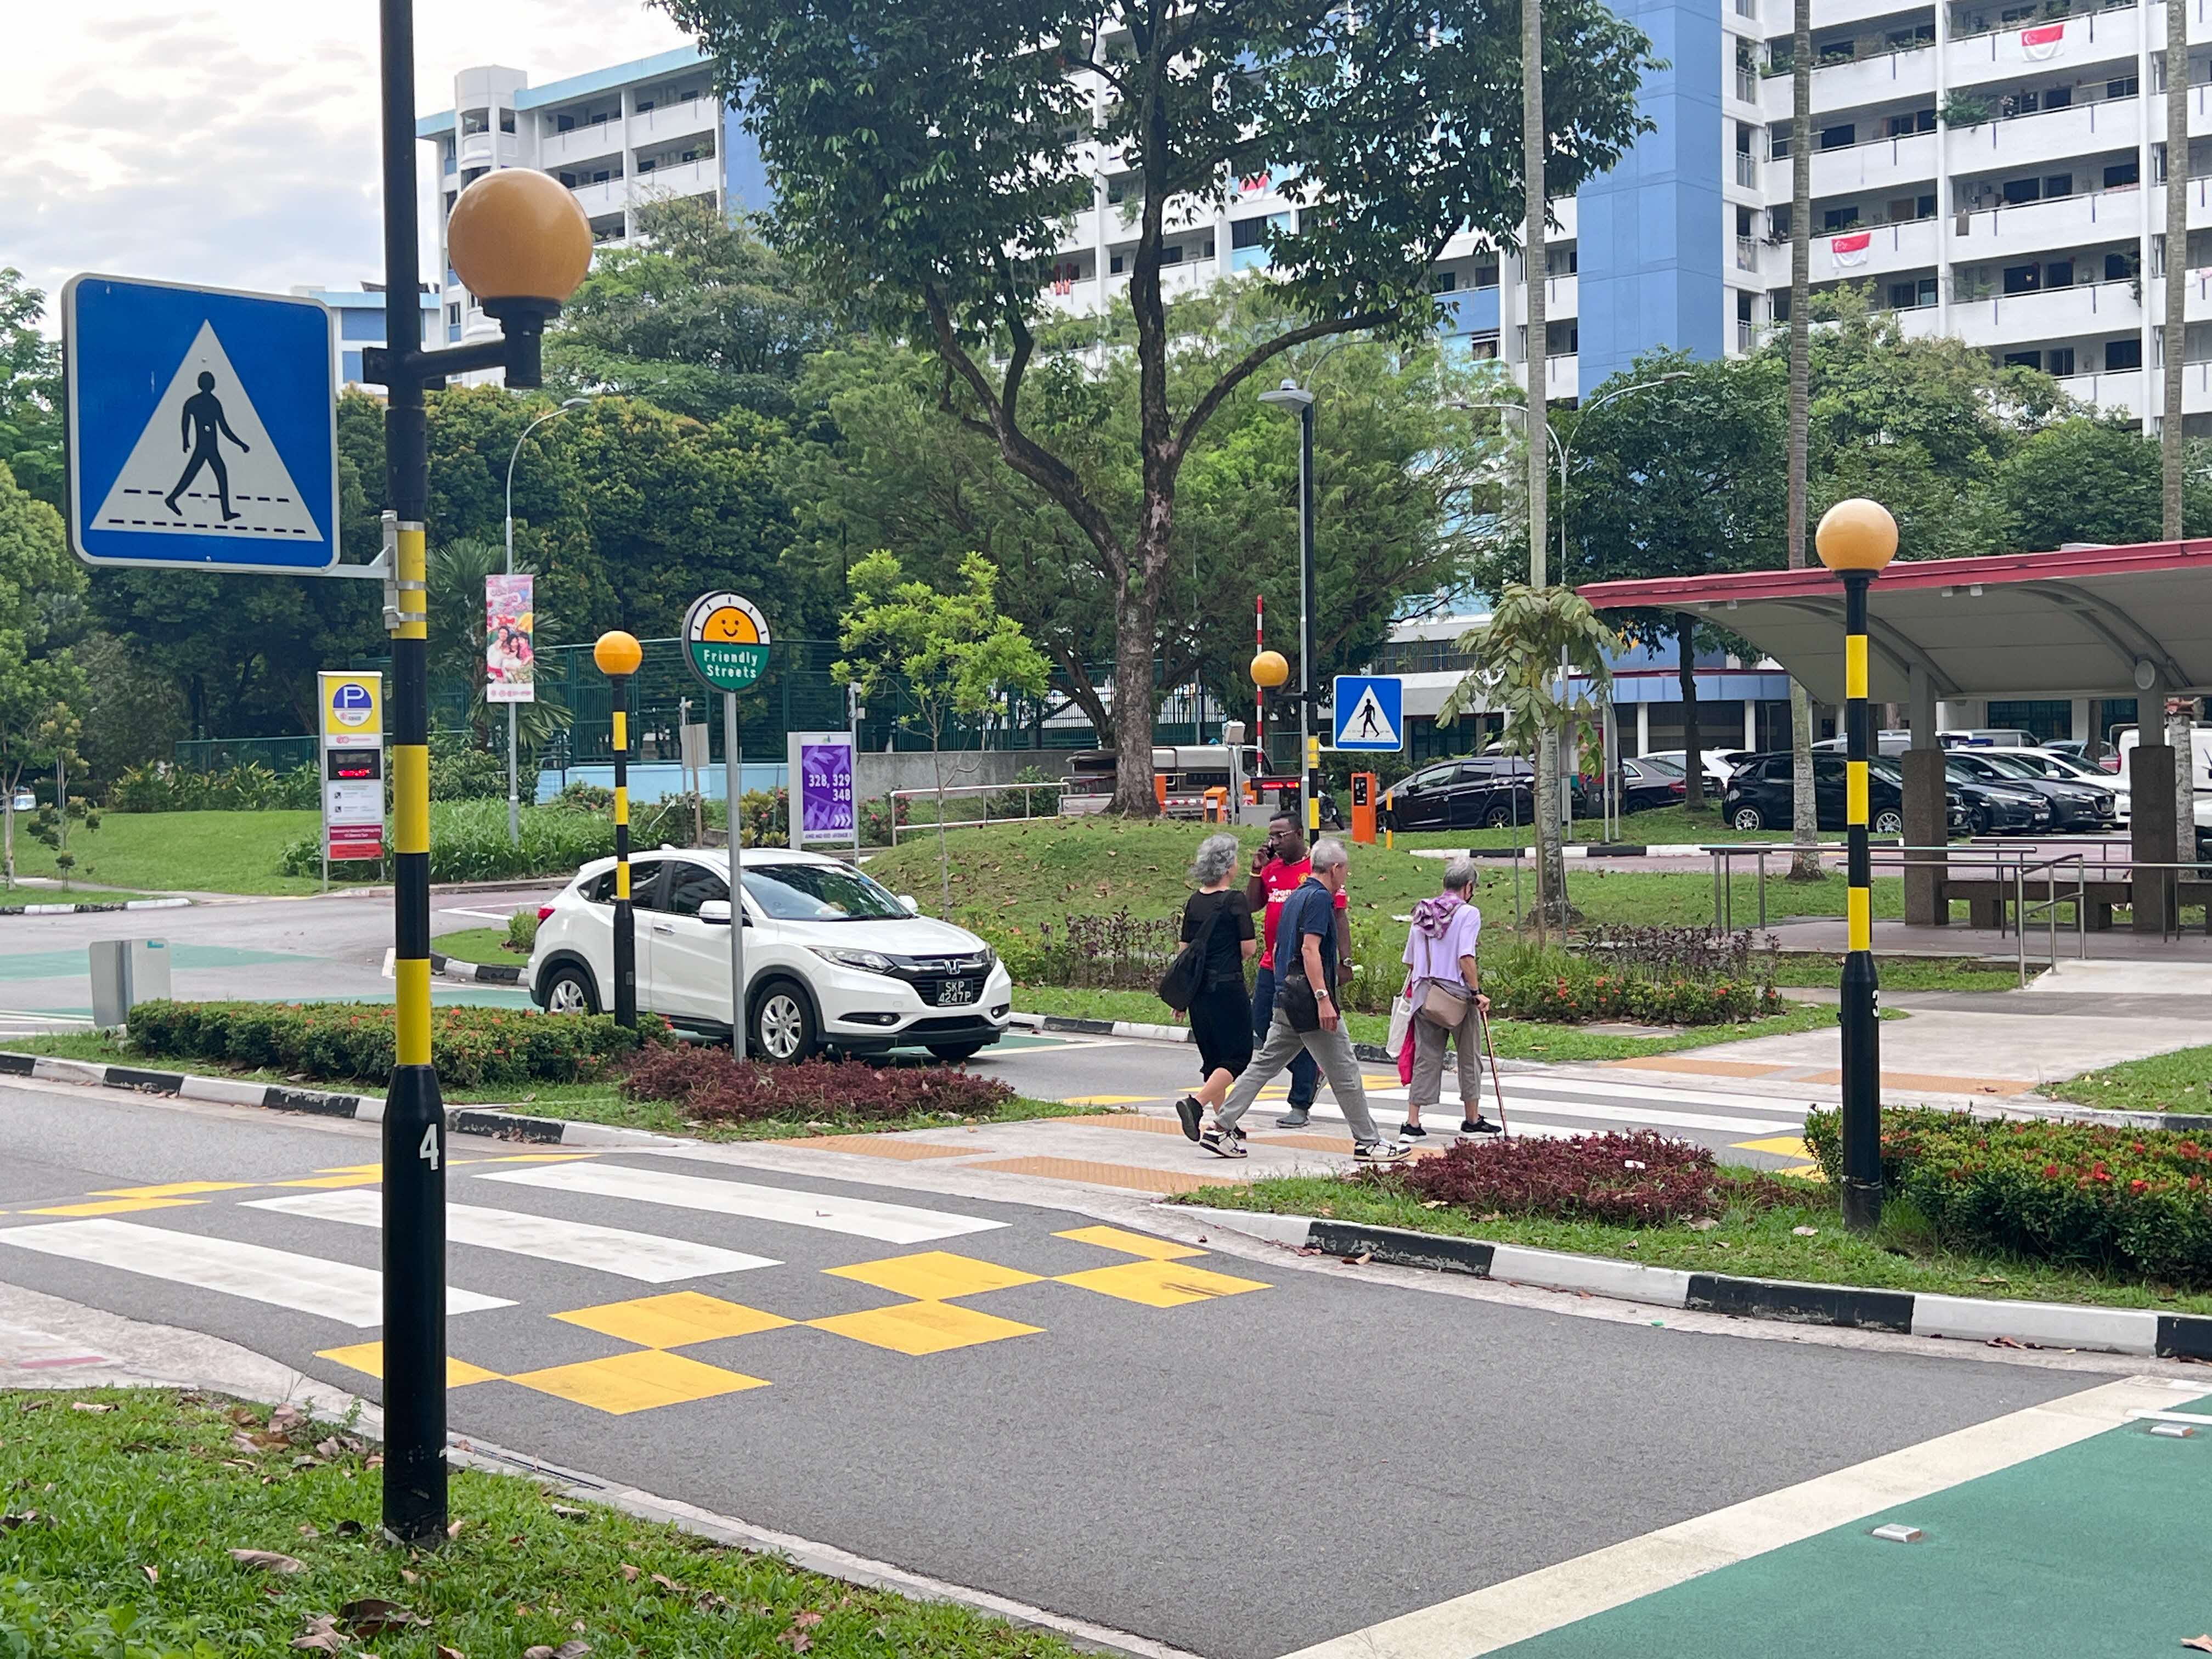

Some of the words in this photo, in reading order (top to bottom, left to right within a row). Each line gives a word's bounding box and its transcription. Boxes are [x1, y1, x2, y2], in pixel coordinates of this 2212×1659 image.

[703, 649, 758, 667] Friendly
[706, 664, 757, 678] Streets
[343, 686, 365, 708] P
[809, 774, 830, 788] 328,
[832, 774, 850, 786] 329
[832, 788, 850, 801] 348
[946, 981, 964, 992] SKP
[939, 991, 971, 1003] 4247P
[1872, 990, 1880, 1017] 3
[420, 1124, 439, 1170] 4
